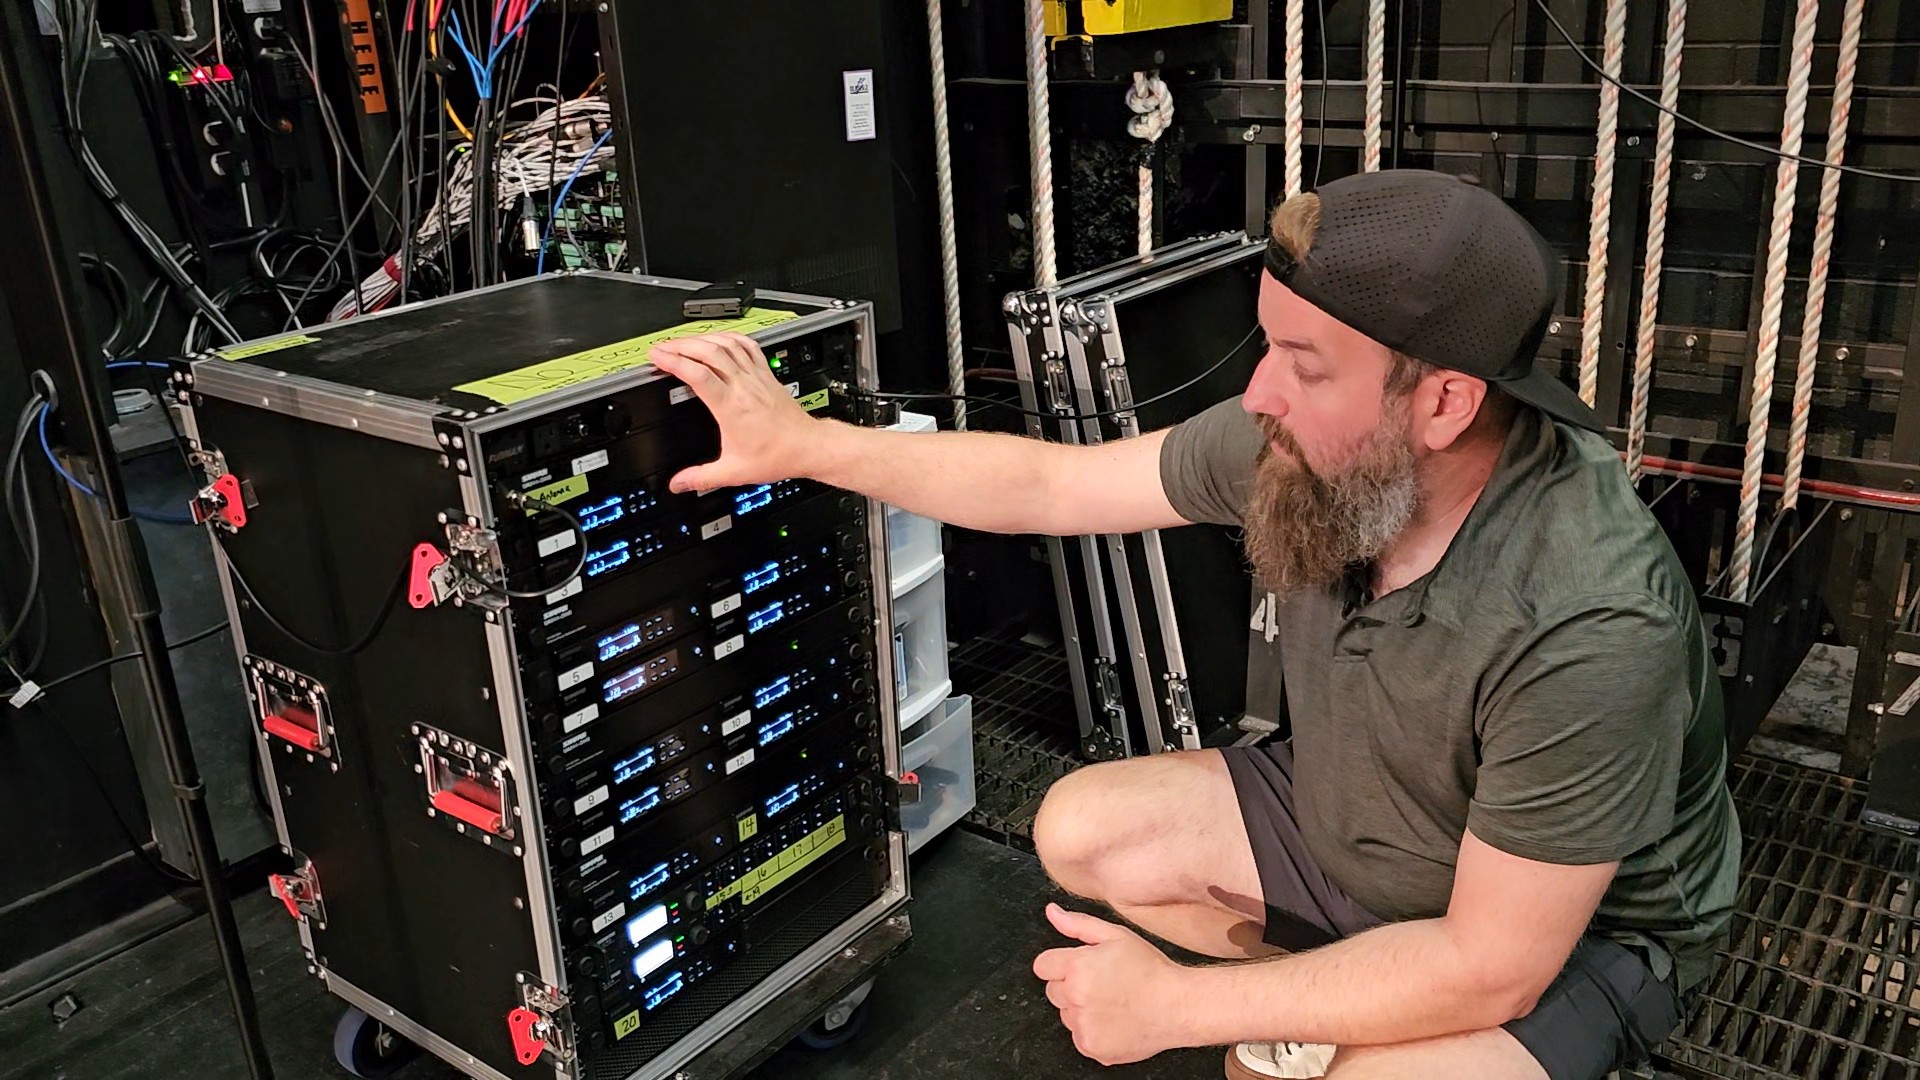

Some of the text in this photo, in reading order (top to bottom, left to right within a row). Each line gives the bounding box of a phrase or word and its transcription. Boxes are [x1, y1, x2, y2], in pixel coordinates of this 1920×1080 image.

[351, 21, 380, 96] HERE
[486, 368, 575, 391] NO
[713, 522, 719, 531] 4
[724, 600, 729, 611] 6
[1250, 592, 1279, 643] 4
[726, 642, 732, 652] 8
[572, 671, 580, 682] 5
[576, 713, 584, 724] 7
[732, 718, 740, 728] 10
[735, 756, 745, 767] 12
[588, 794, 594, 805] 9
[742, 818, 754, 836] 14
[826, 822, 835, 836] 18
[594, 835, 602, 846] 11
[792, 844, 802, 858] 17
[757, 868, 766, 880] 16
[603, 912, 614, 924] 13
[622, 1015, 636, 1033] 20
